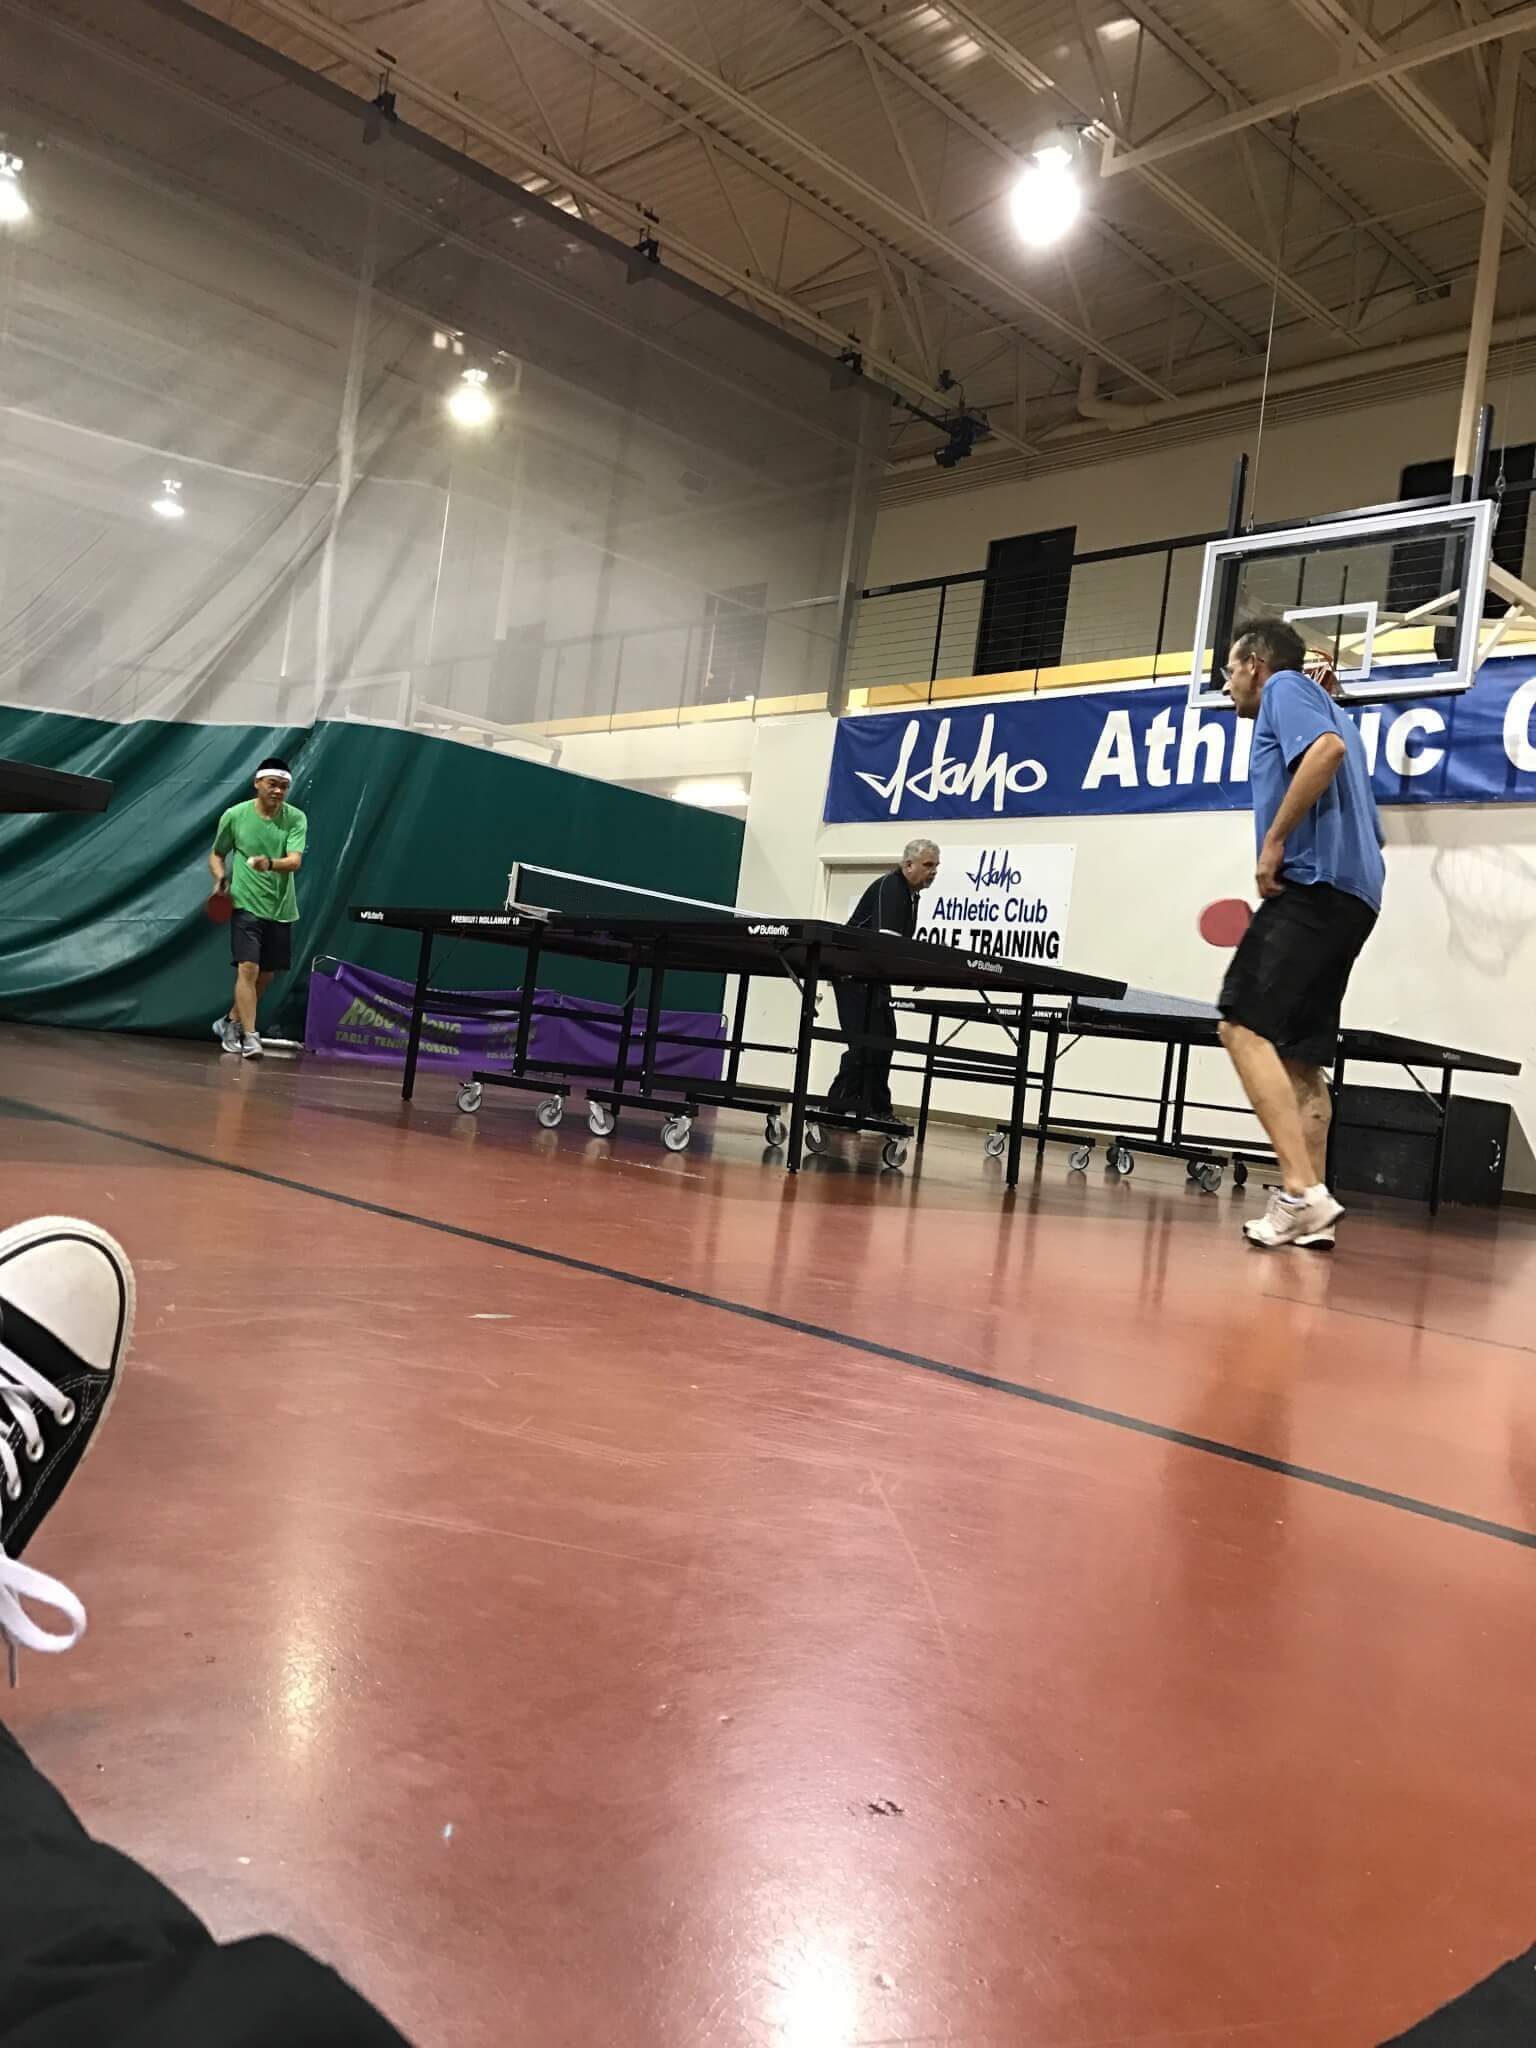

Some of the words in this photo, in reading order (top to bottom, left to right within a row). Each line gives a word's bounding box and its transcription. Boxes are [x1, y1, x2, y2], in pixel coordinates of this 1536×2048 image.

[932, 897, 999, 922] Athletic
[1004, 897, 1048, 923] Club
[970, 928, 1060, 959] TRAINING
